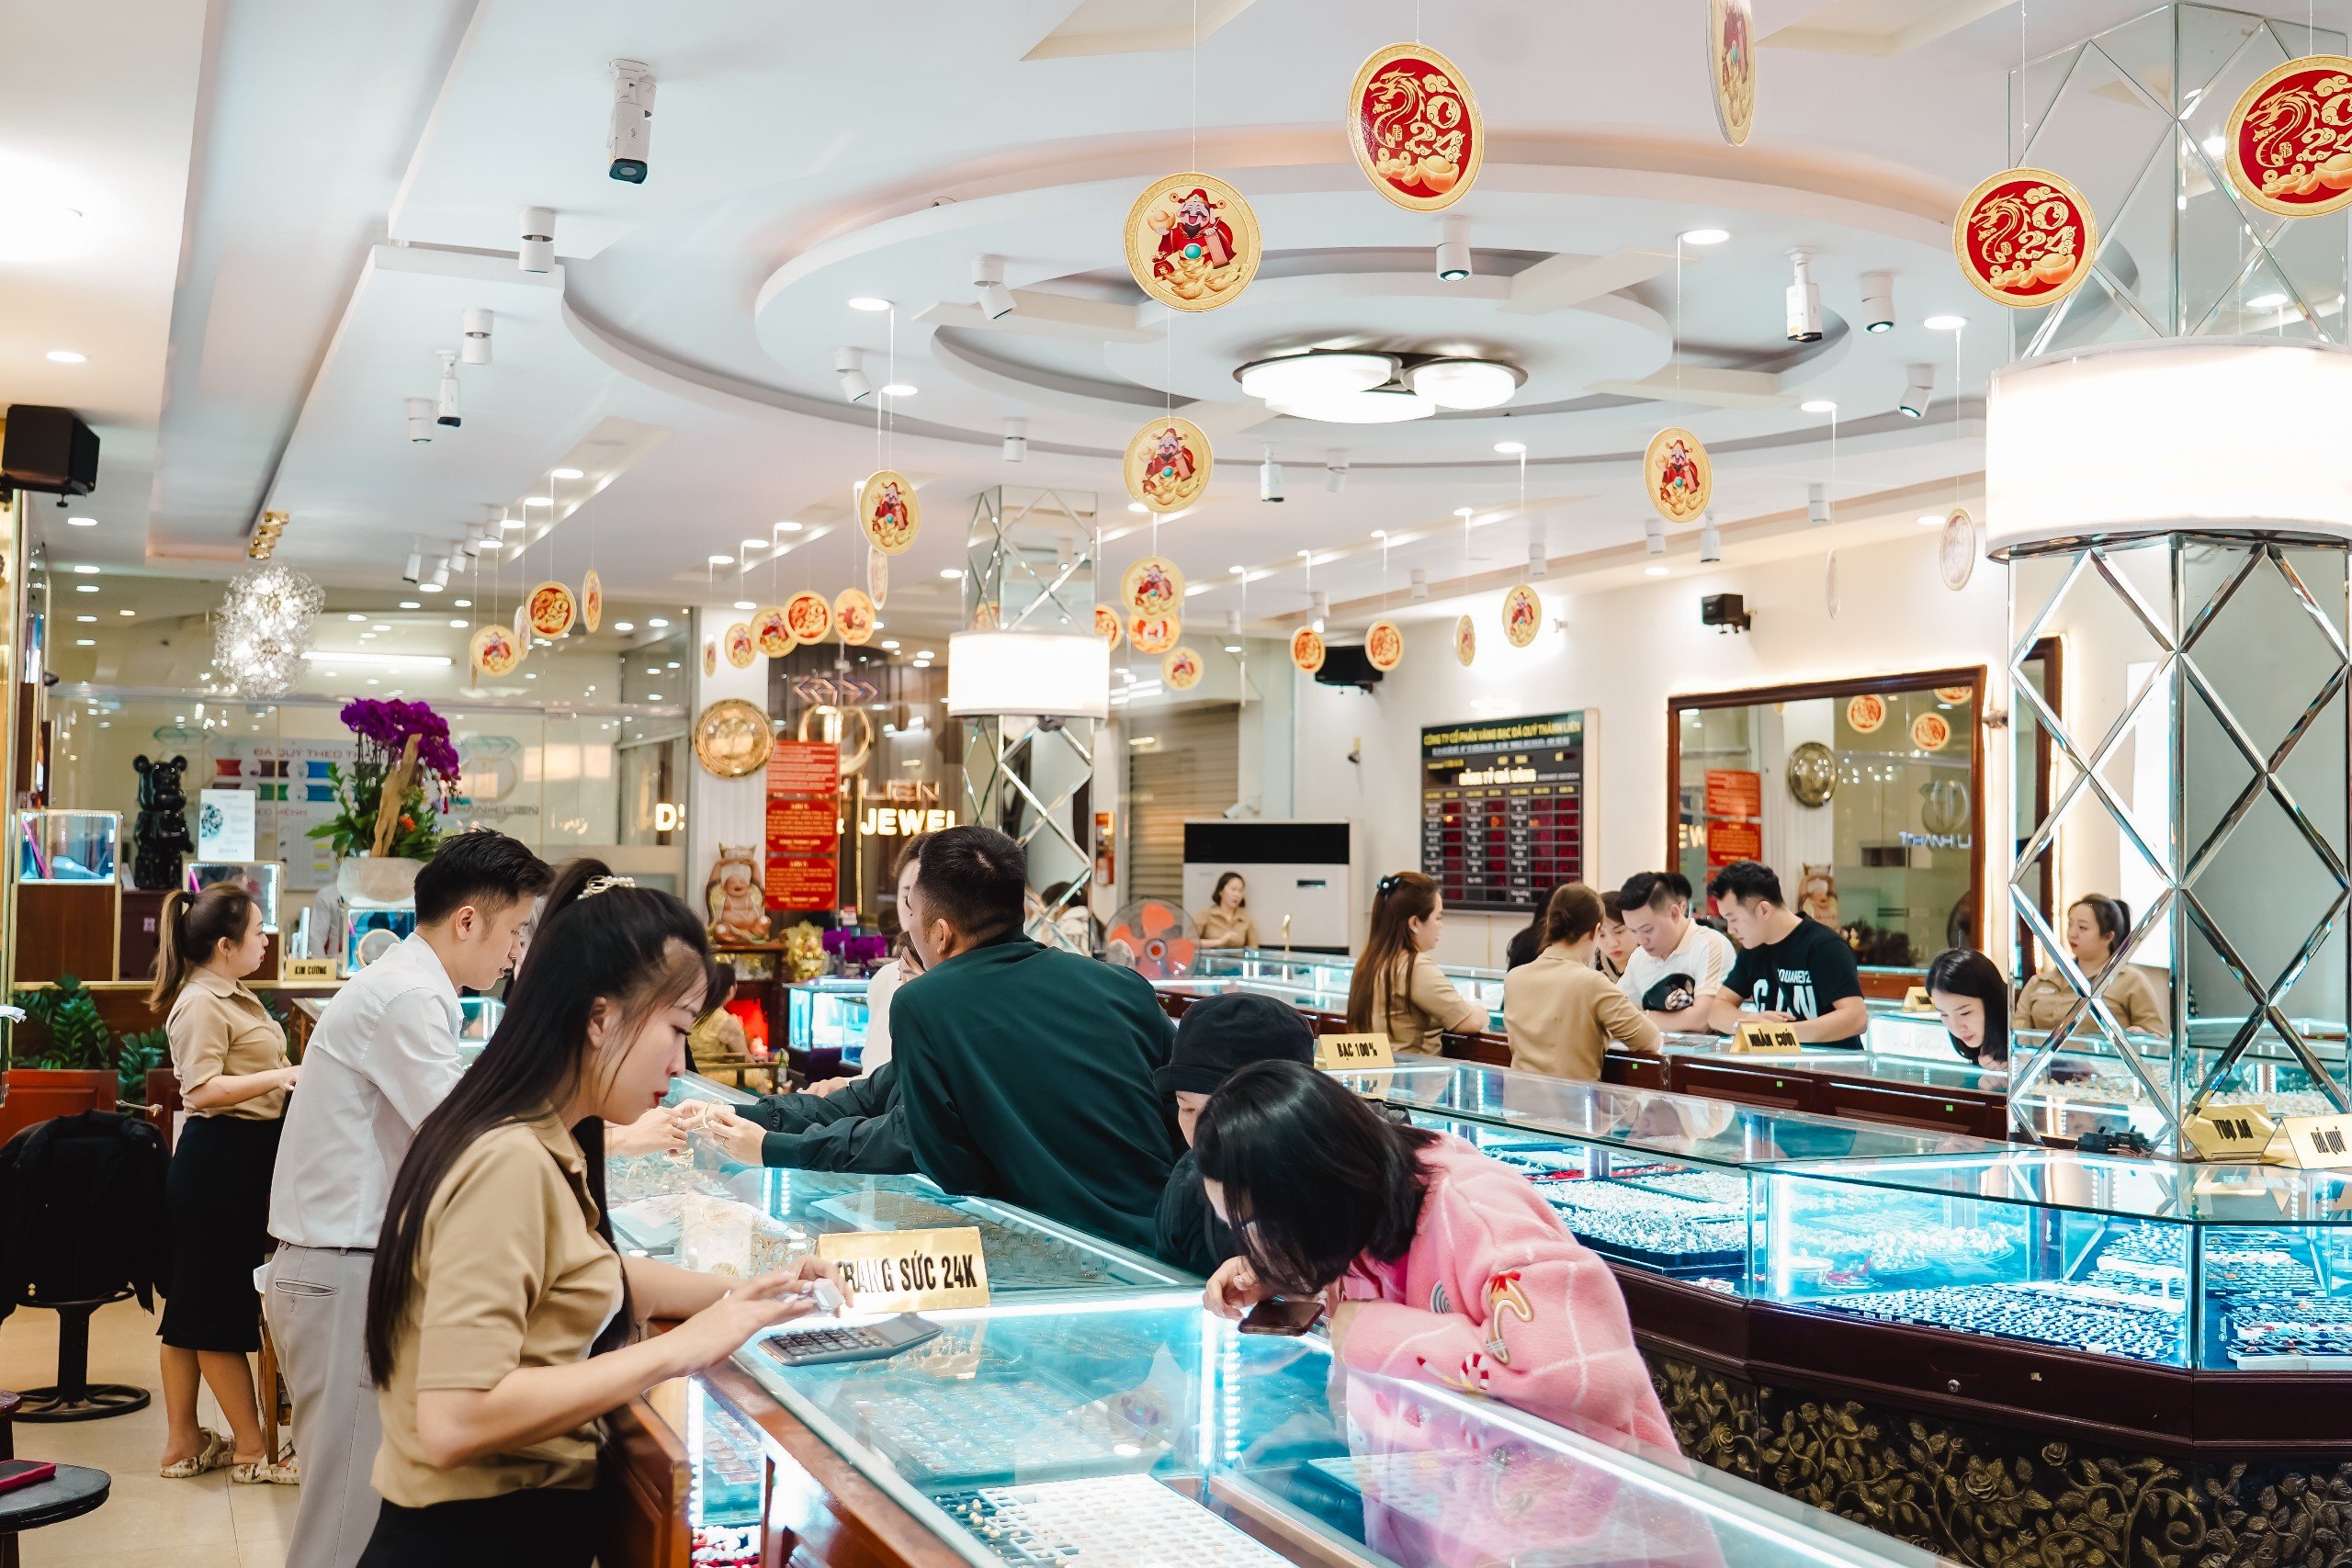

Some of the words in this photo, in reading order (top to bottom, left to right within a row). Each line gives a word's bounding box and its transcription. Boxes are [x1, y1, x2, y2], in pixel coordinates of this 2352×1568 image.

[1337, 1043, 1353, 1061] BẠC
[1354, 1042, 1378, 1057] 100%
[899, 1248, 936, 1292] SỨC
[941, 1253, 978, 1289] 24K
